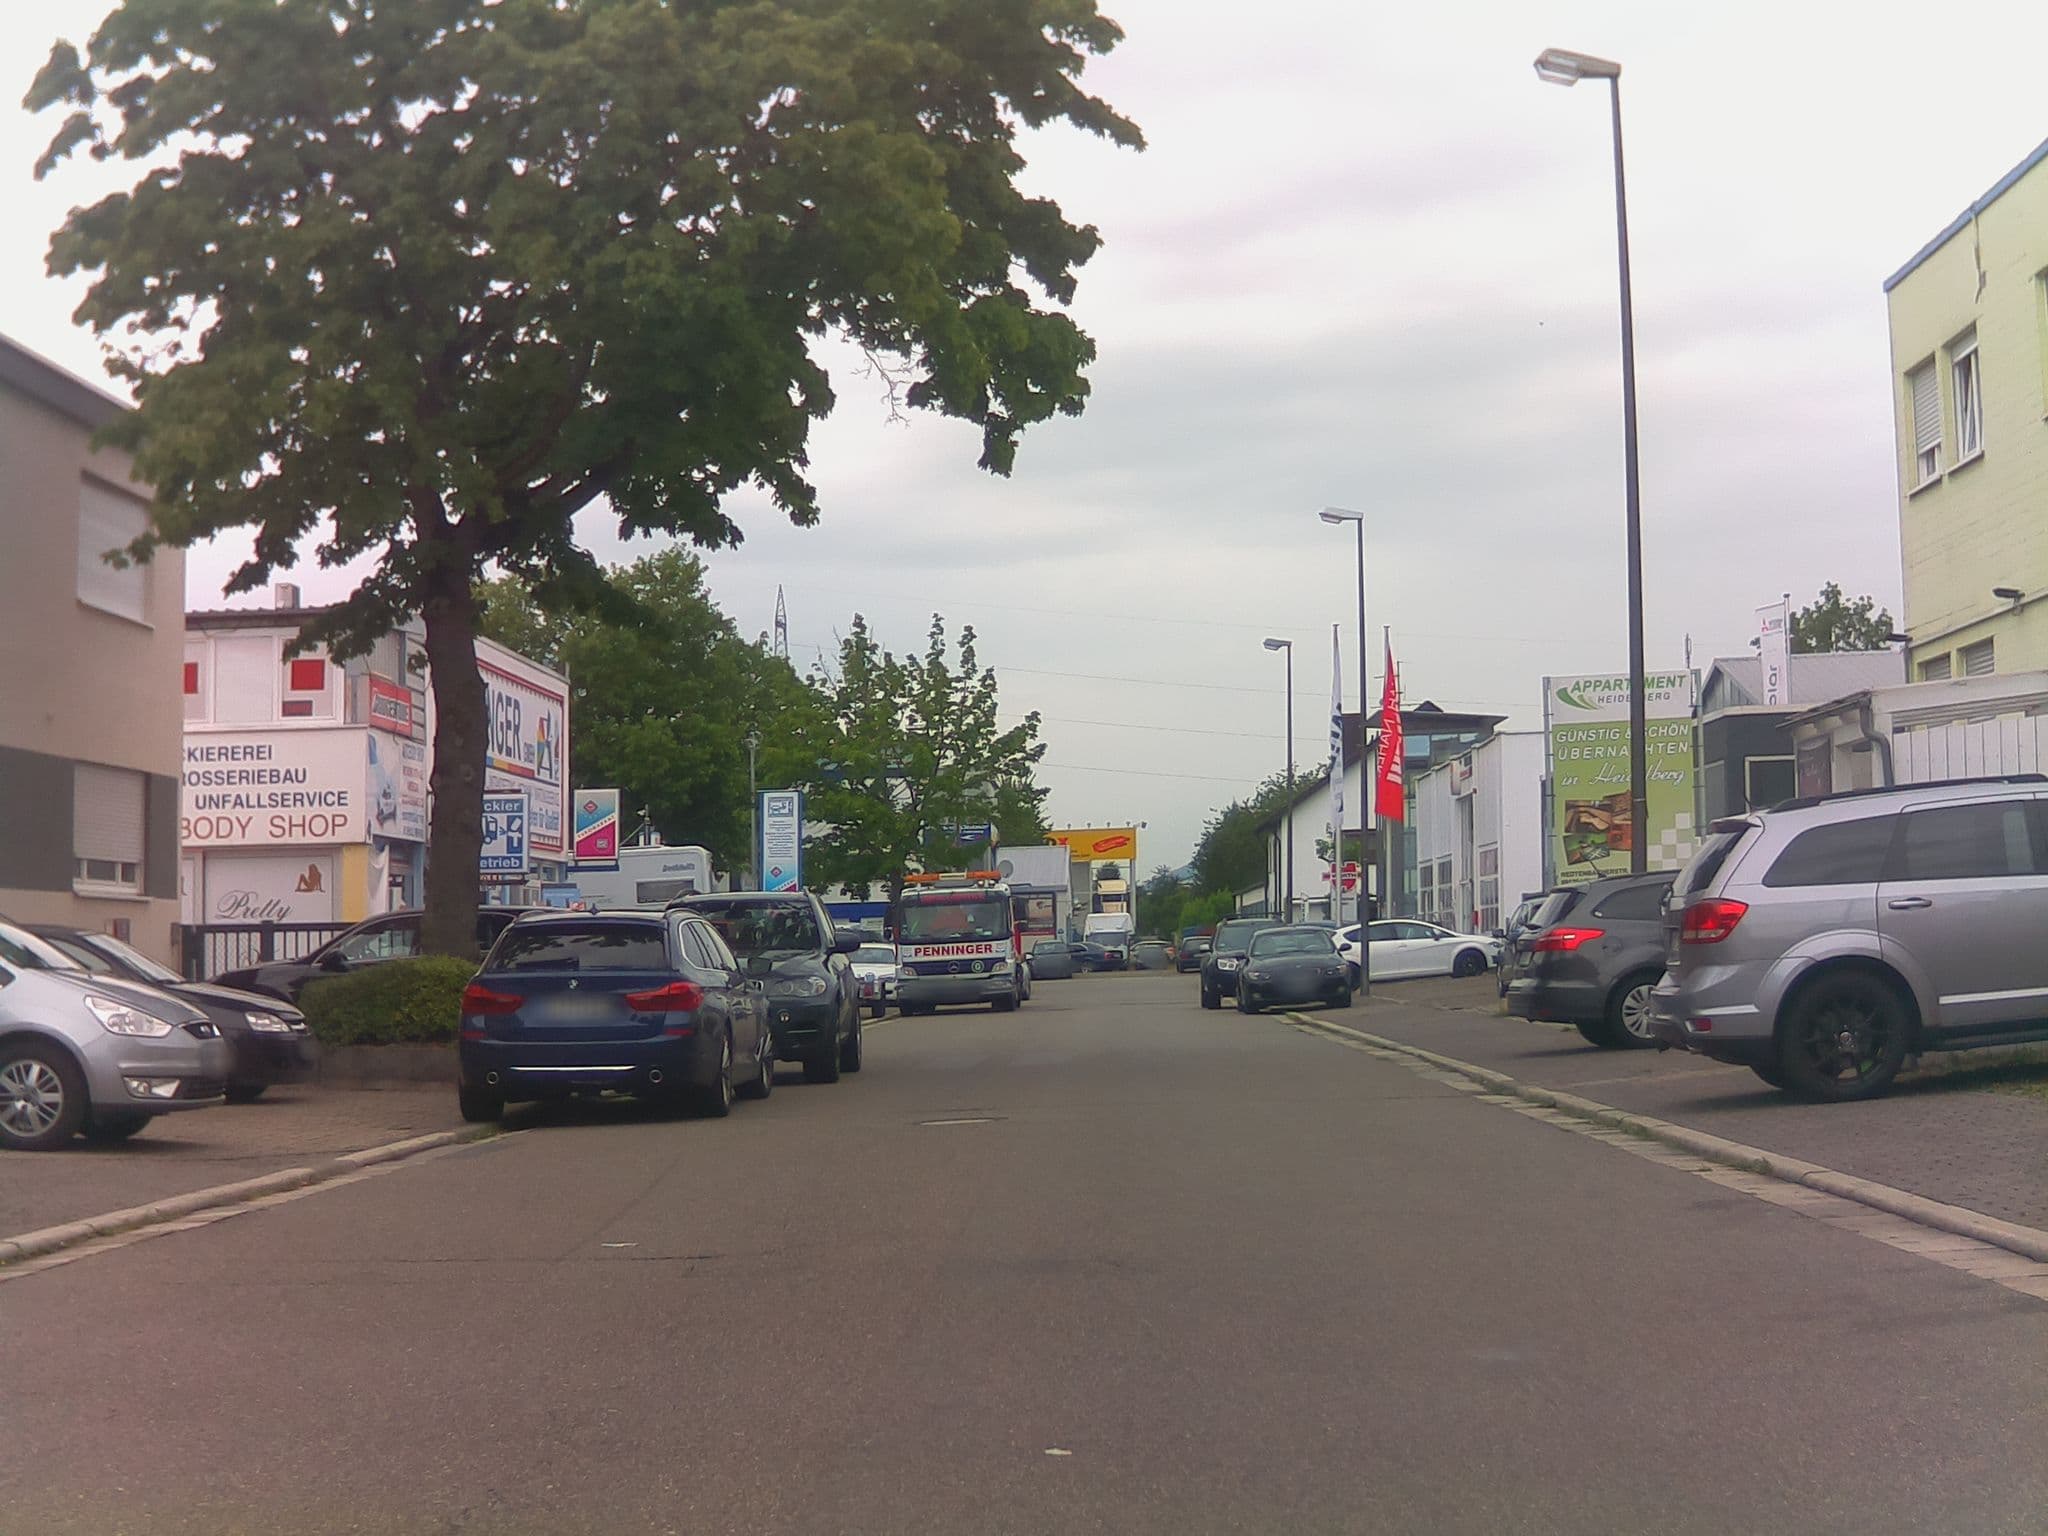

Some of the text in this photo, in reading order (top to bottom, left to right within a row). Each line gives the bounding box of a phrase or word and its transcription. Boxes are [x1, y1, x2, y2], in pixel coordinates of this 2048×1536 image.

[1571, 675, 1686, 693] APPARTMENT
[1556, 728, 1620, 743] GÜNSTIG
[183, 744, 273, 763] KIEREREI
[1558, 741, 1688, 760] ÜBERNAHTEN
[195, 791, 348, 810] UNFALLSERVICE
[483, 800, 520, 812] ckier
[182, 813, 349, 840] BODY SHOP
[480, 857, 520, 868] etrieb
[915, 944, 992, 956] PENNINGER
